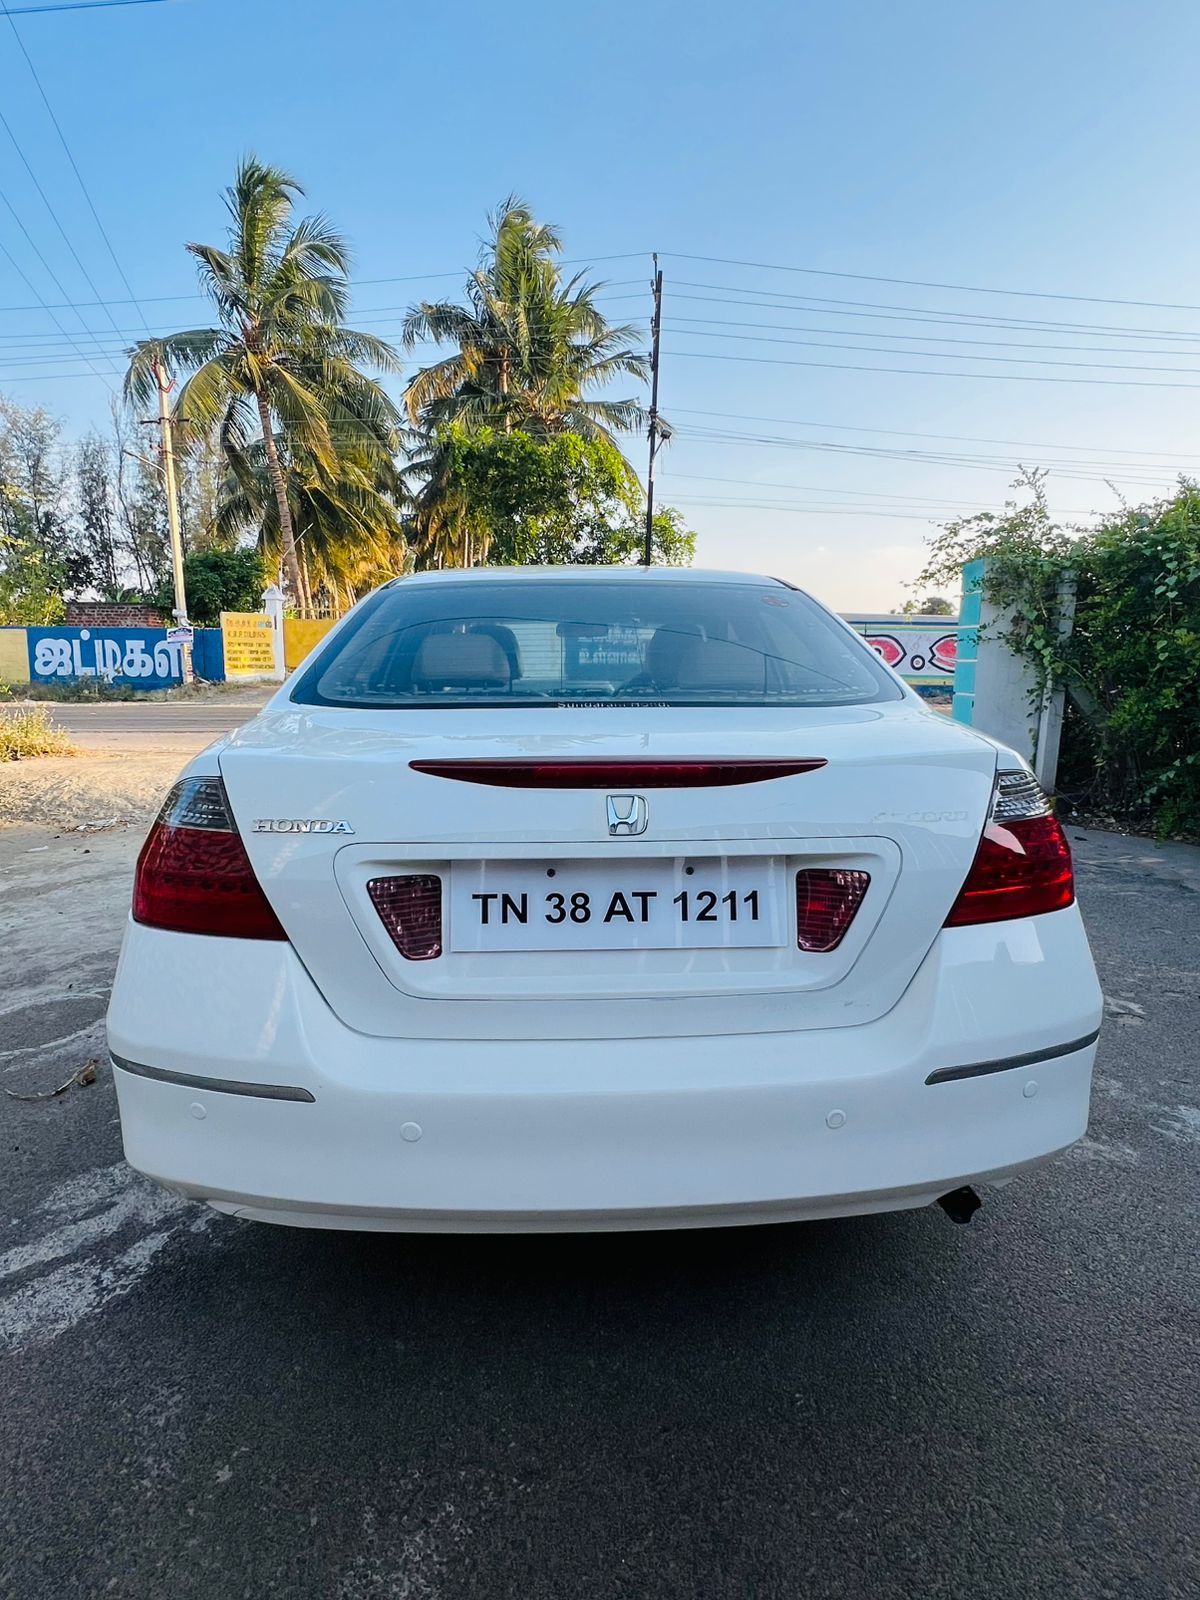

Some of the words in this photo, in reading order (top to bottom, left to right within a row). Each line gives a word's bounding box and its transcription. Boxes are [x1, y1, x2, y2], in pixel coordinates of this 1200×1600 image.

[252, 819, 355, 834] HONDA
[472, 893, 528, 924] TN
[545, 892, 591, 924] 38
[603, 891, 657, 922] AT
[673, 890, 759, 921] 1211
